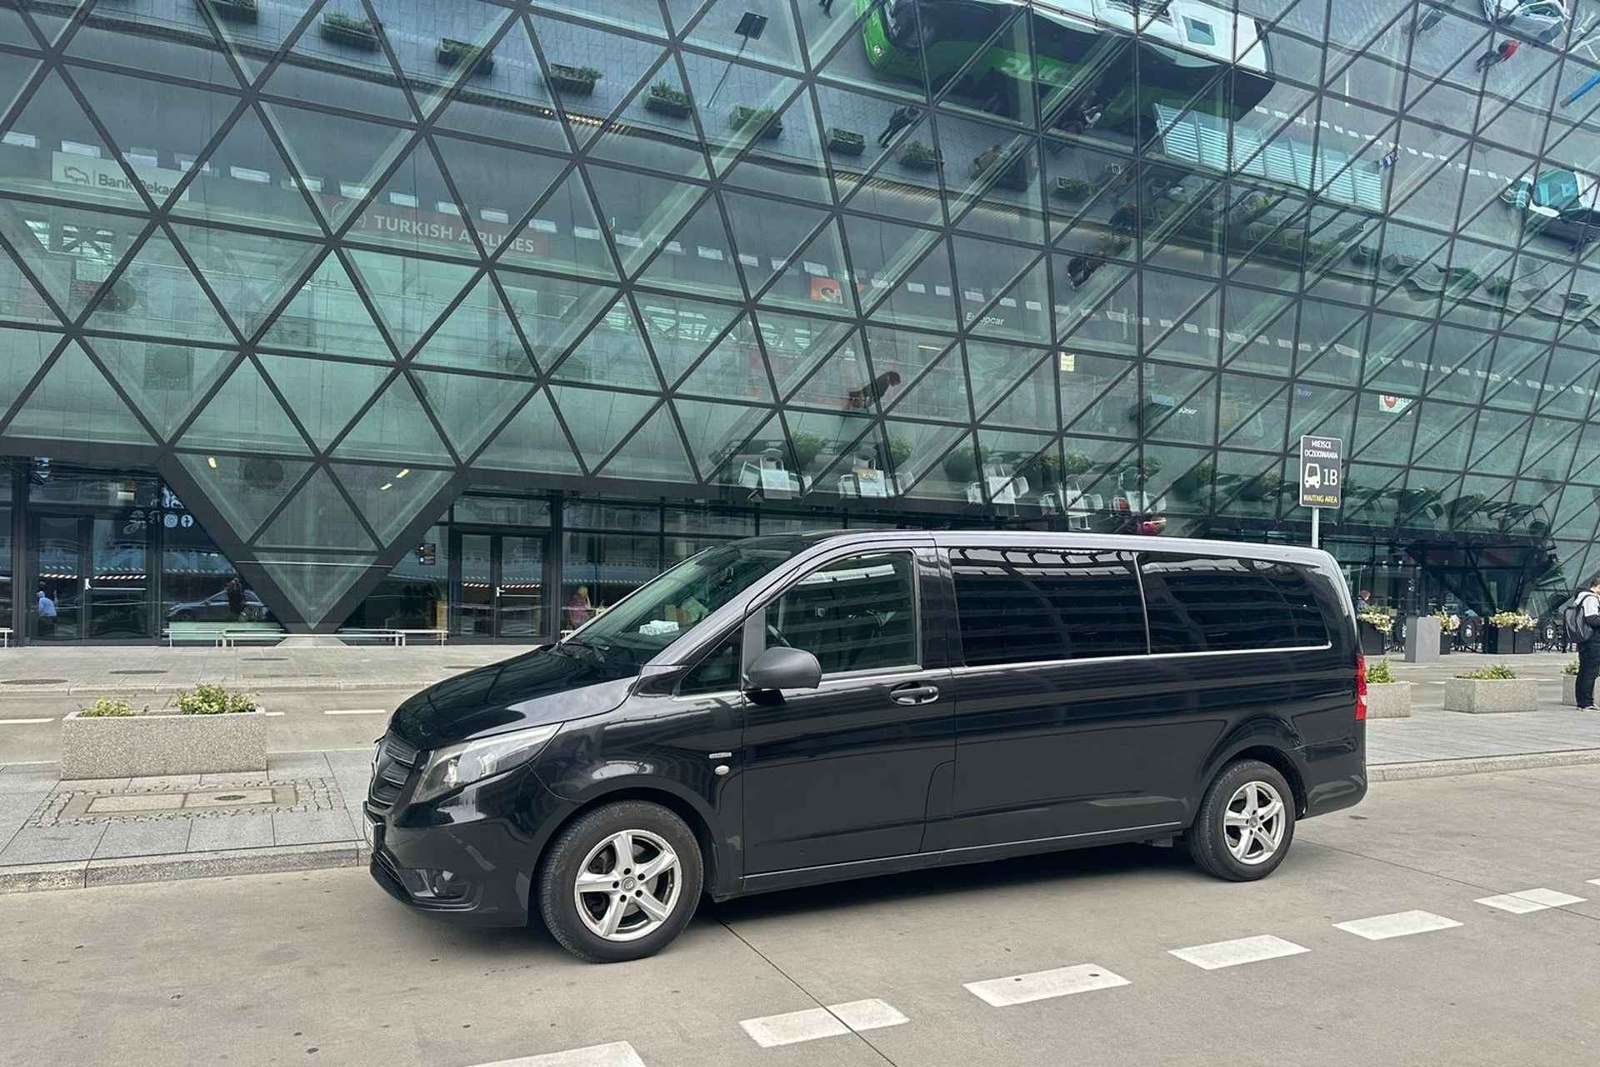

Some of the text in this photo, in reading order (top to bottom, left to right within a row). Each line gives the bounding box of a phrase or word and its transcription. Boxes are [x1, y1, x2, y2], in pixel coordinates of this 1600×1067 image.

[374, 215, 453, 241] TURKISH
[1323, 468, 1338, 486] 1B
[1324, 496, 1338, 504] AREA
